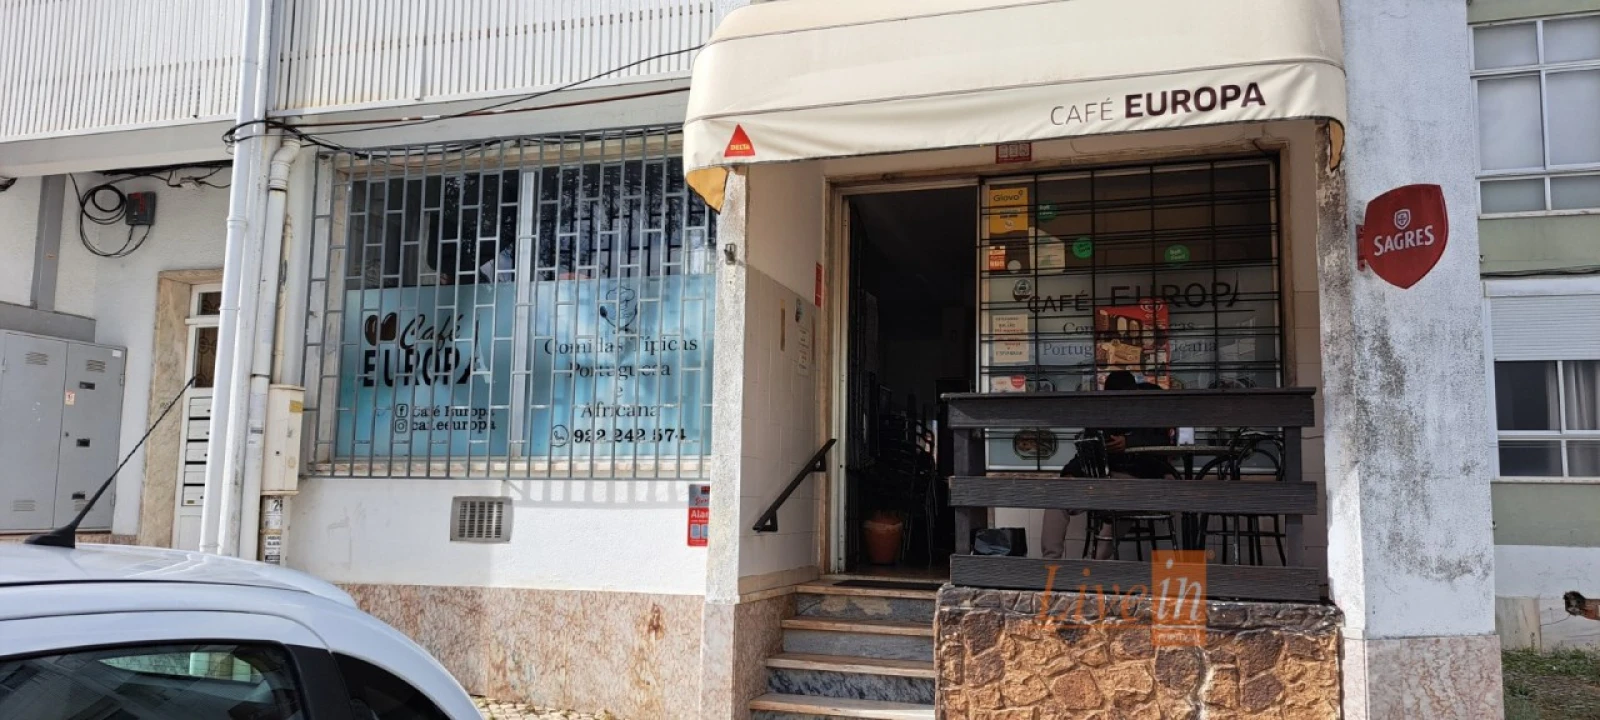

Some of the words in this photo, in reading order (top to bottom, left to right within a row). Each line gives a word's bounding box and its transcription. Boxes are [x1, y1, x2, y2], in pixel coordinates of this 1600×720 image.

[1050, 97, 1114, 126] CAFÉ
[1124, 82, 1266, 118] EUROPA
[1373, 225, 1435, 256] SAGRES
[1026, 290, 1090, 314] CAFÉ
[399, 313, 465, 352] Café
[363, 319, 492, 388] EUROPA
[573, 428, 606, 444] 922
[614, 428, 646, 443] 242
